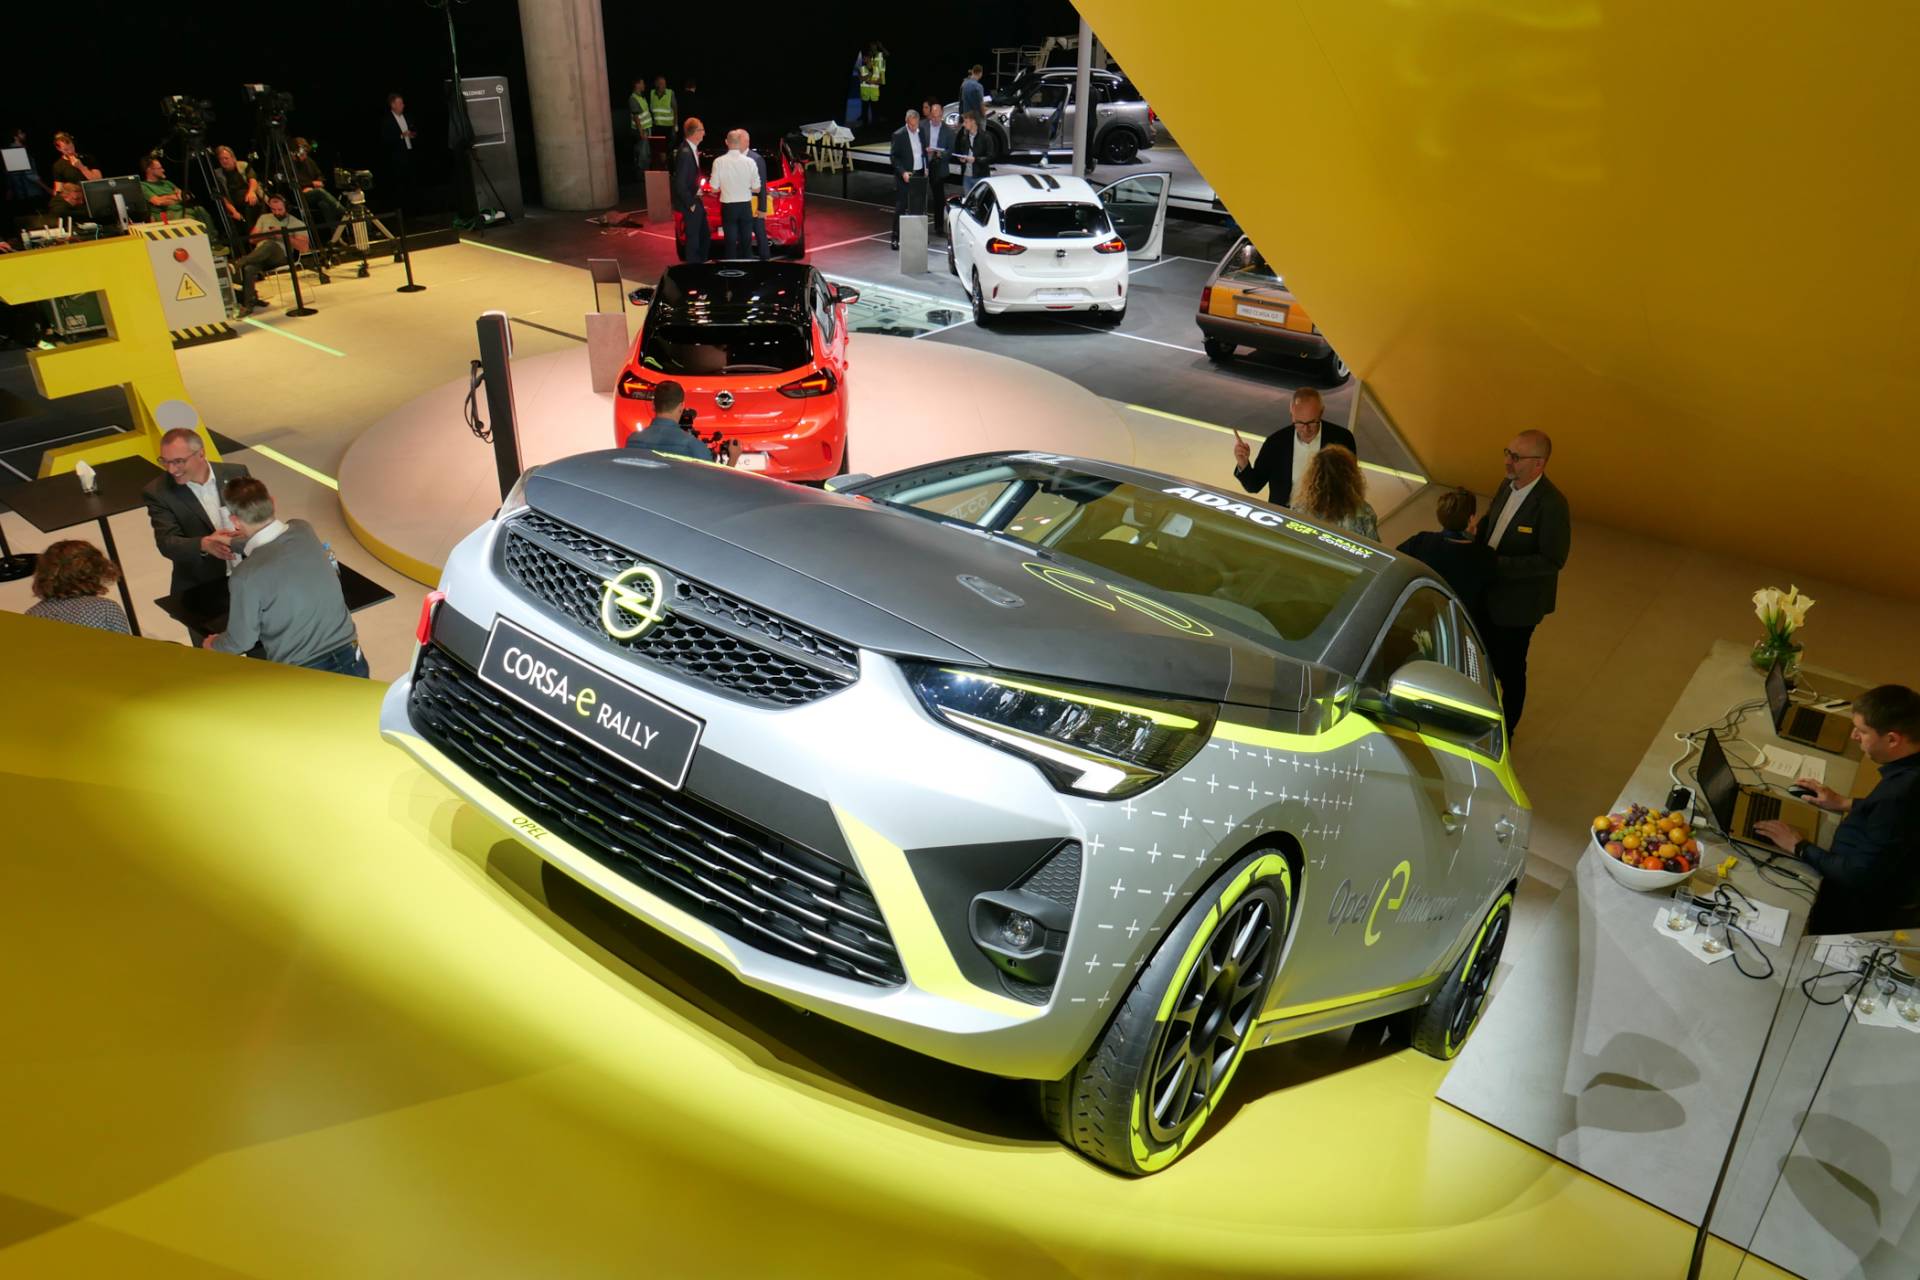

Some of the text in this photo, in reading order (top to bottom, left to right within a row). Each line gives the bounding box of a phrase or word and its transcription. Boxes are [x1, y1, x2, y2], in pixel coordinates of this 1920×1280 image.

[1162, 487, 1283, 526] ADAC
[1318, 536, 1370, 557] CONCEPT
[503, 648, 659, 749] CORSA-e RALLY
[512, 816, 548, 840] OPEL
[1328, 878, 1380, 937] Opel
